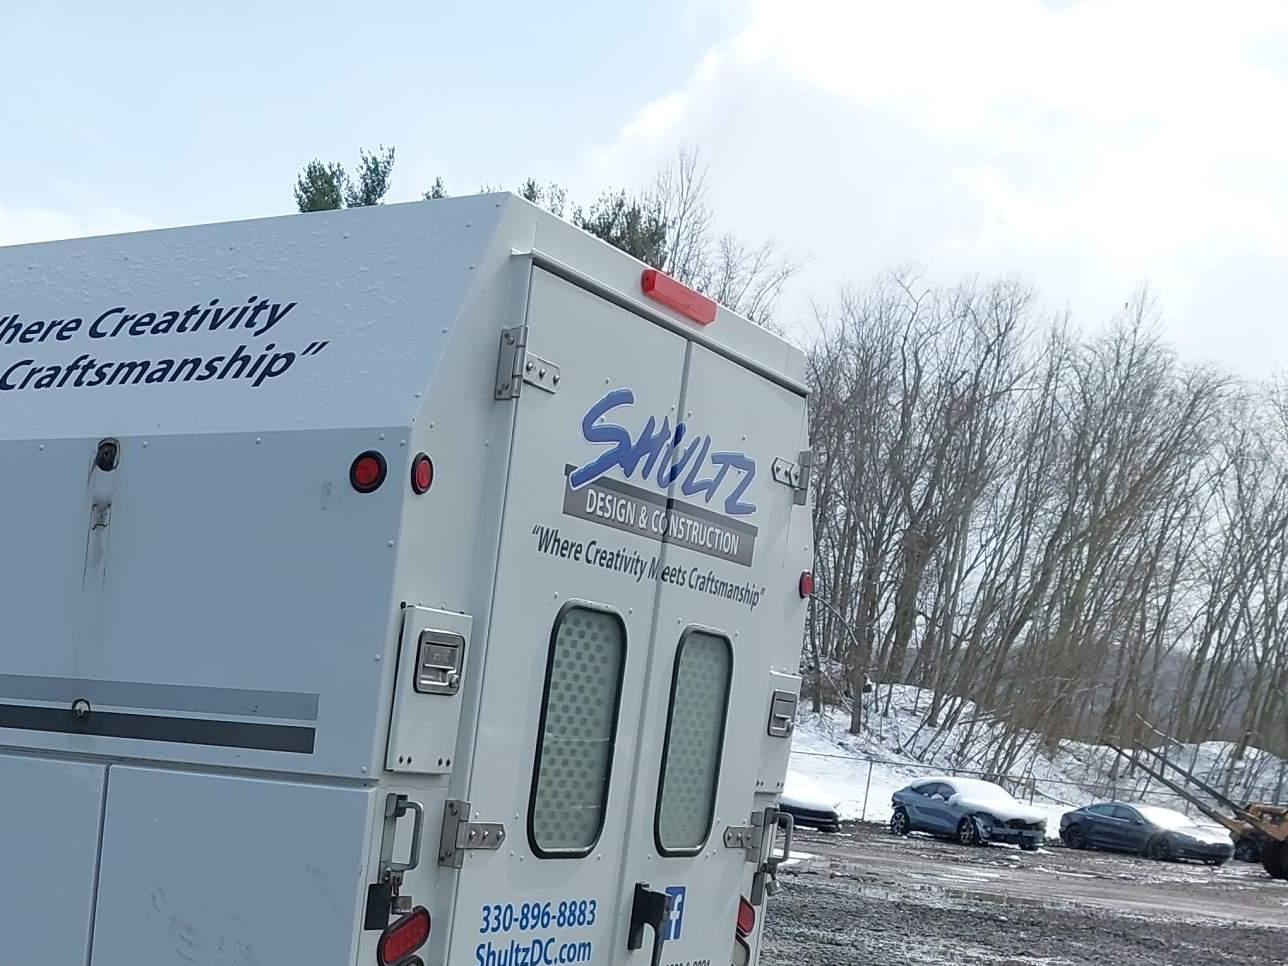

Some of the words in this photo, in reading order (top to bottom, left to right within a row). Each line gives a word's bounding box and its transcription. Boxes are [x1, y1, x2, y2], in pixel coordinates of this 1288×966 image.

[88, 295, 298, 339] Creativity
[569, 388, 757, 515] SHULTZ
[585, 488, 636, 527] DESIGN
[638, 506, 648, 529] &
[651, 509, 740, 556] CONSTRUCTION
[585, 539, 648, 583] Creativity
[648, 557, 687, 587] Meets
[479, 898, 598, 935] 330-896-8883
